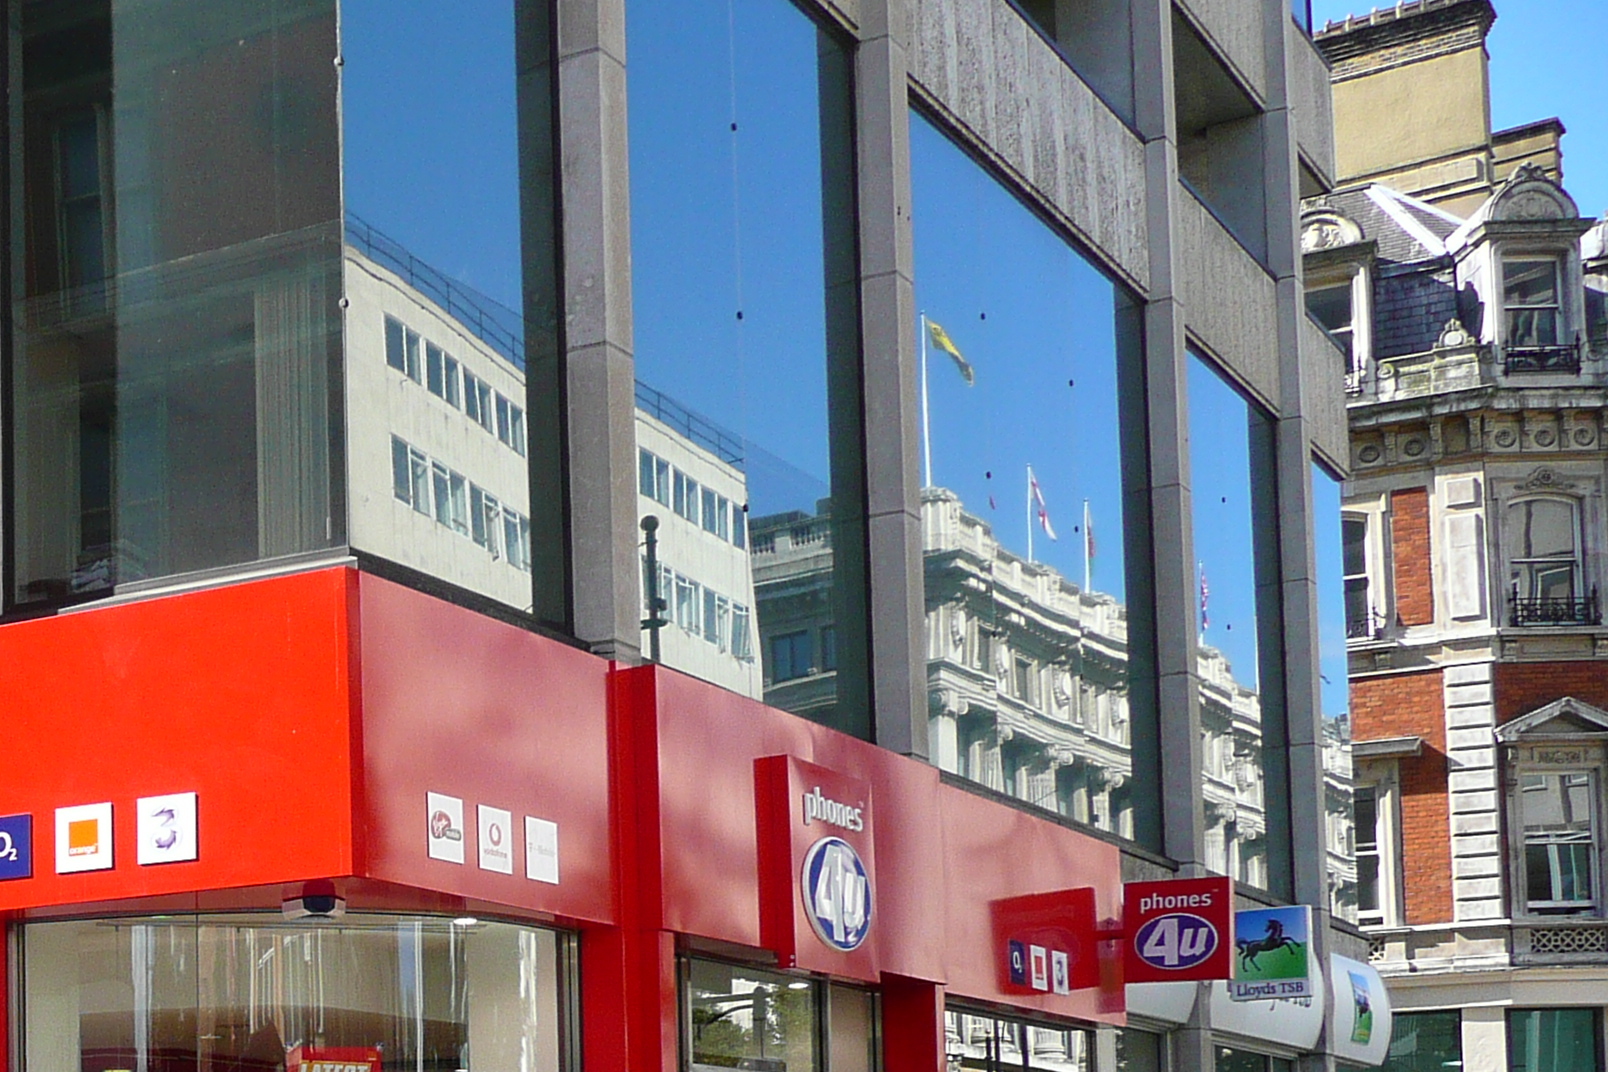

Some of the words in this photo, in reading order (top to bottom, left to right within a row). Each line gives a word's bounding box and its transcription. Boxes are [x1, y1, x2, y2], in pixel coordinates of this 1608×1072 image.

[803, 786, 863, 832] phones
[815, 844, 866, 942] 4u
[1140, 891, 1212, 914] phones
[1142, 918, 1209, 965] 4u
[1236, 982, 1277, 999] Lloyds
[1278, 981, 1304, 994] TSB
